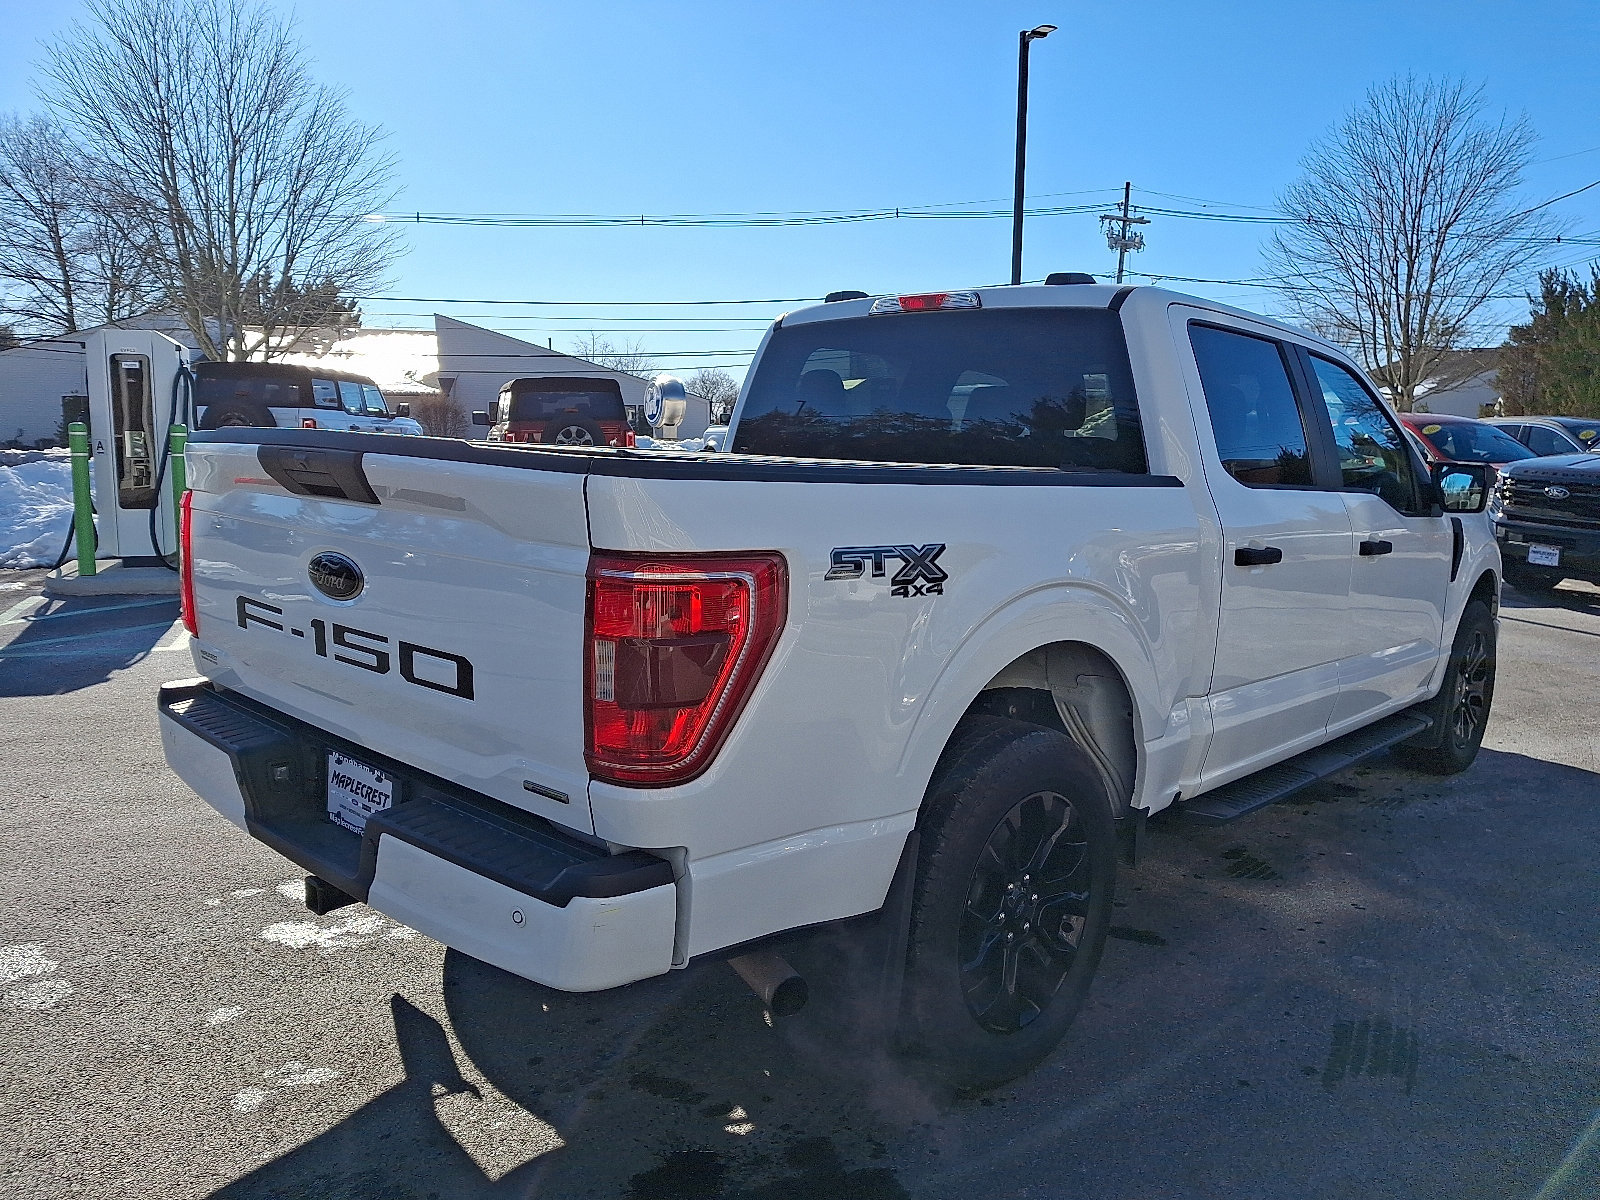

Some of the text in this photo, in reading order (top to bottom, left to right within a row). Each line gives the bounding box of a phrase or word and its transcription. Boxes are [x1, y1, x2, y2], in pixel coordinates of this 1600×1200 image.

[314, 562, 346, 590] Ford
[824, 543, 949, 587] STX
[236, 595, 475, 701] F-150
[331, 770, 390, 808] MAPLECREST
